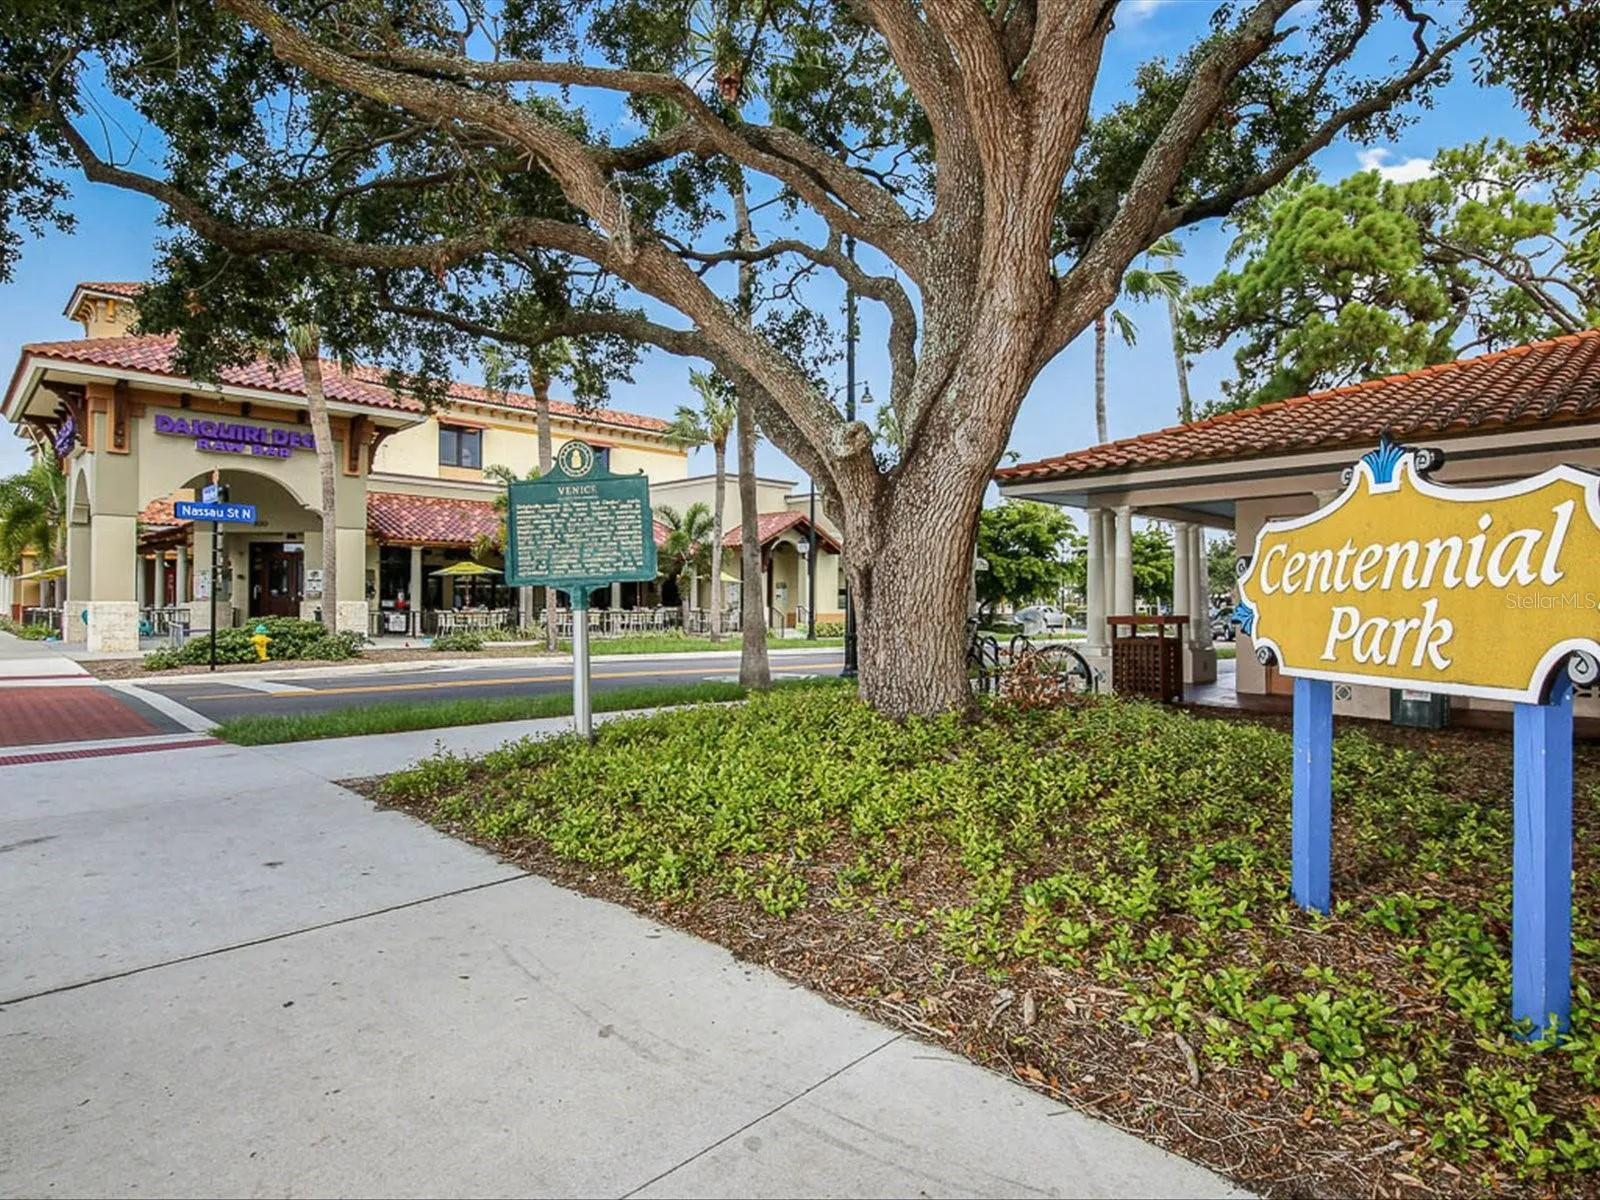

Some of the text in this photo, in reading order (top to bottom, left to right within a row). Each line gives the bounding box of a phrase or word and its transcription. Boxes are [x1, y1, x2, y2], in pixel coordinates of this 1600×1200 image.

[155, 413, 315, 448] DAIQUIRI DEC
[196, 438, 290, 458] RAW BAR
[557, 485, 597, 495] VENICE
[182, 505, 251, 519] Nassau St N
[1259, 499, 1576, 595] Centennial
[1320, 597, 1454, 671] Park
